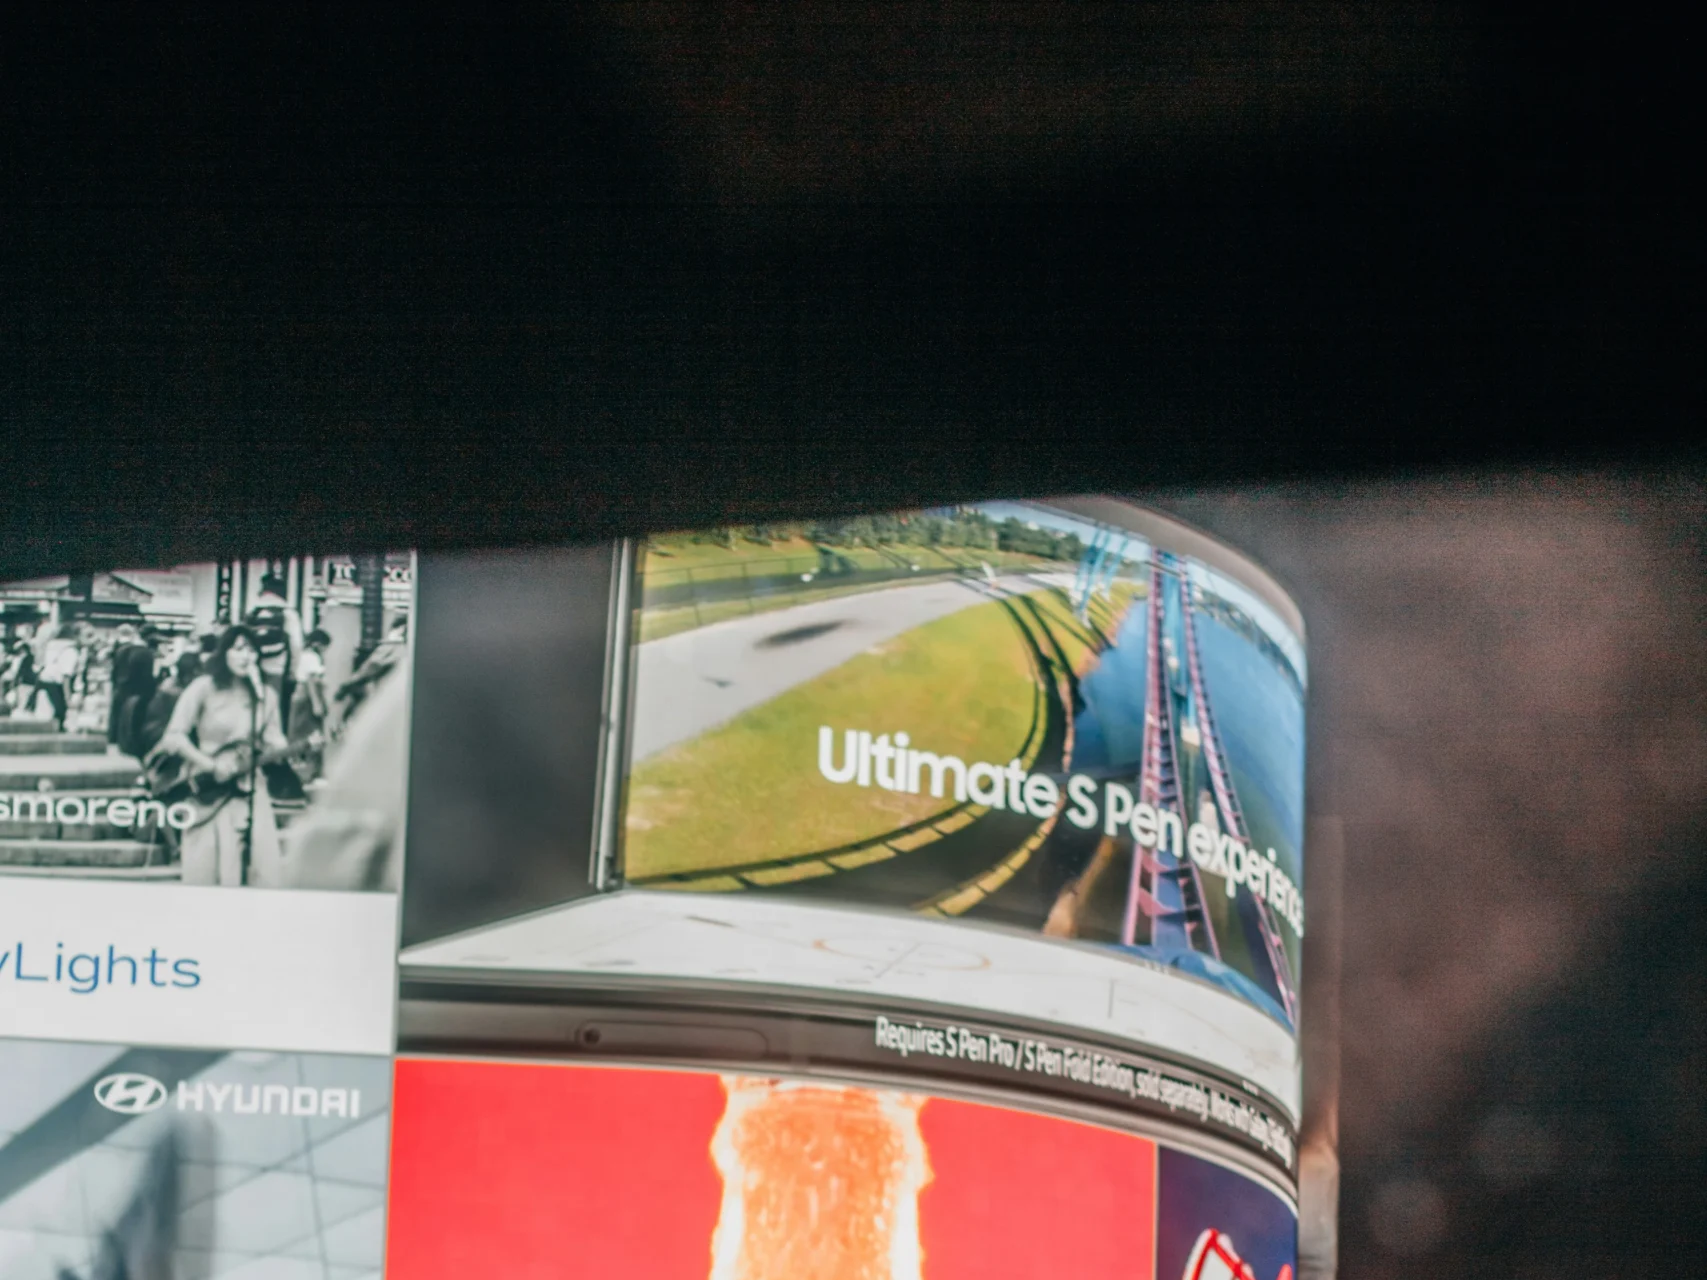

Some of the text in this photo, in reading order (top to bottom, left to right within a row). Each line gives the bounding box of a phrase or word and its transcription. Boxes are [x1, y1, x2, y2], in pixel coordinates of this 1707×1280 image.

[818, 725, 1060, 819] Ultimate
[1066, 774, 1098, 829] S
[1105, 782, 1183, 858] Pen
[875, 1016, 945, 1057] Requires
[946, 1026, 957, 1058] S
[958, 1028, 987, 1063] Pen
[988, 1033, 1014, 1068] Pro
[1024, 1040, 1035, 1072] S
[1036, 1041, 1062, 1077] Pen
[177, 1080, 361, 1118] HYUNDAI
